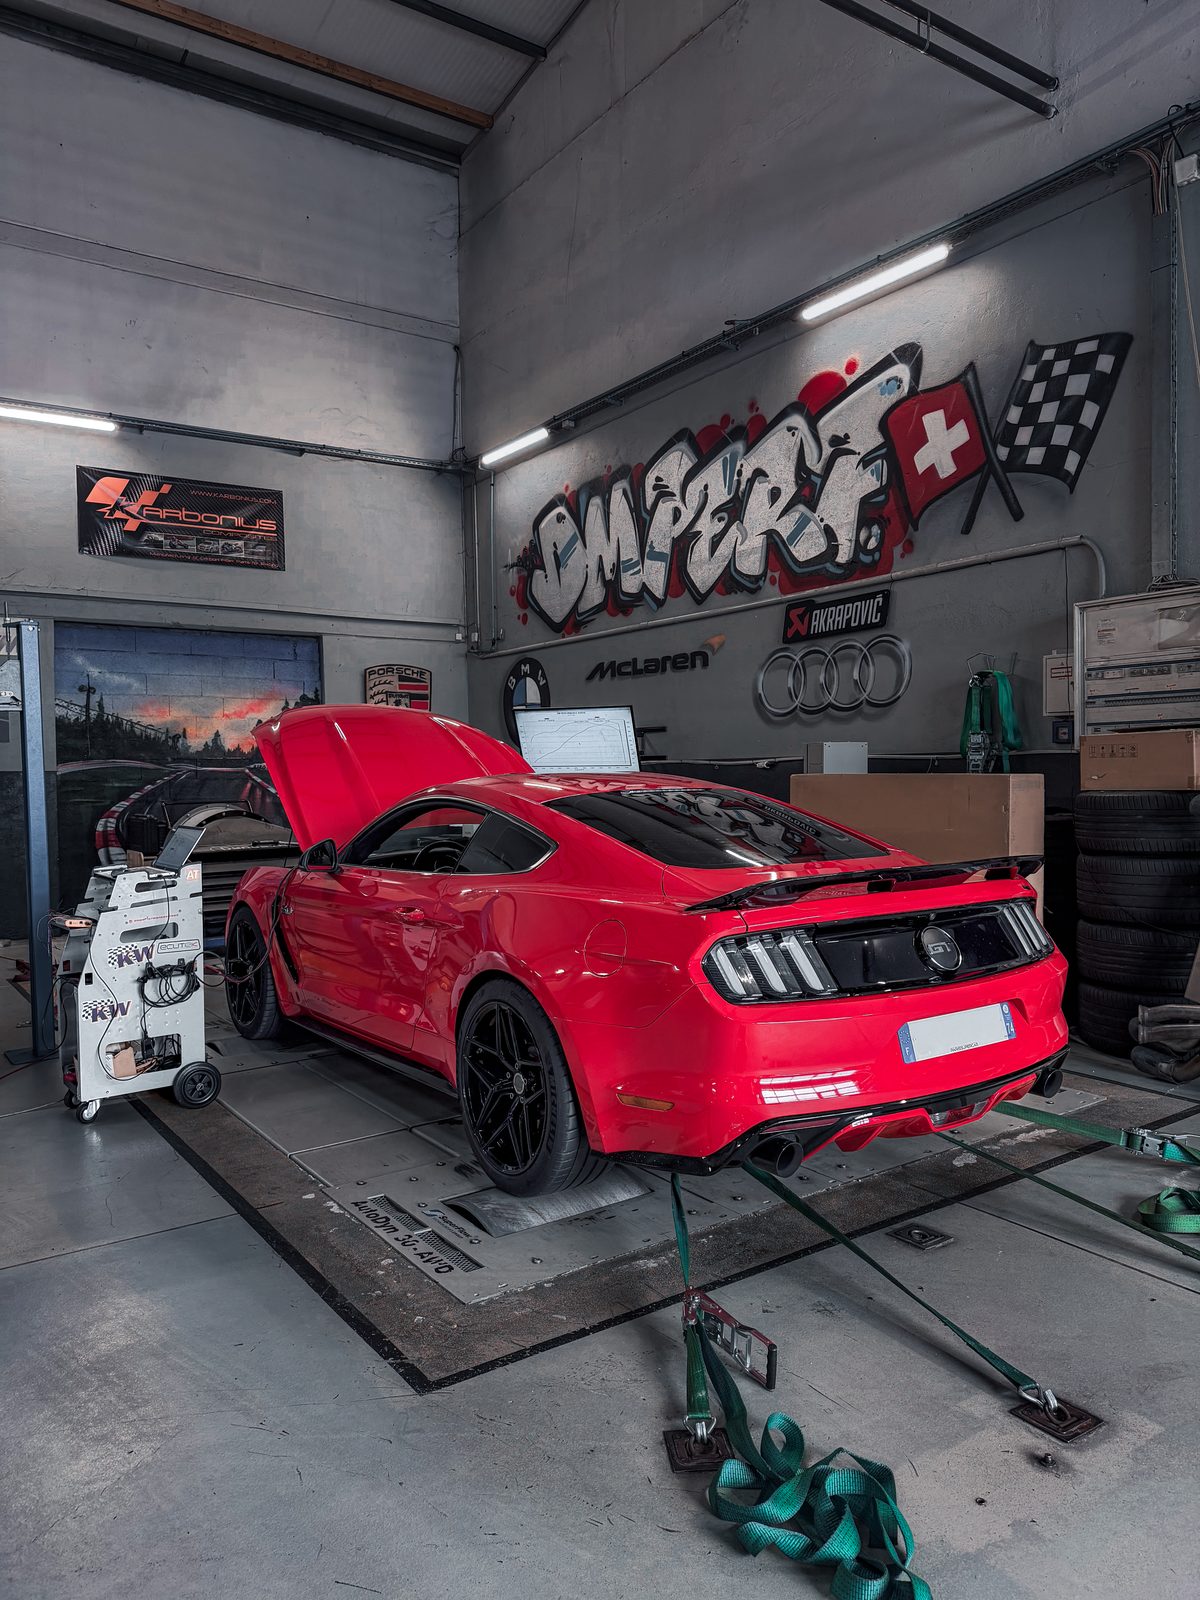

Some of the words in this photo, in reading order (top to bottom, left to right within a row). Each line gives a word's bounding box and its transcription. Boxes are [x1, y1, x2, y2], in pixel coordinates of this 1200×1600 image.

[367, 667, 427, 681] PORSCHE
[585, 650, 709, 681] McLaren
[117, 944, 155, 969] KW
[92, 1000, 131, 1023] KW
